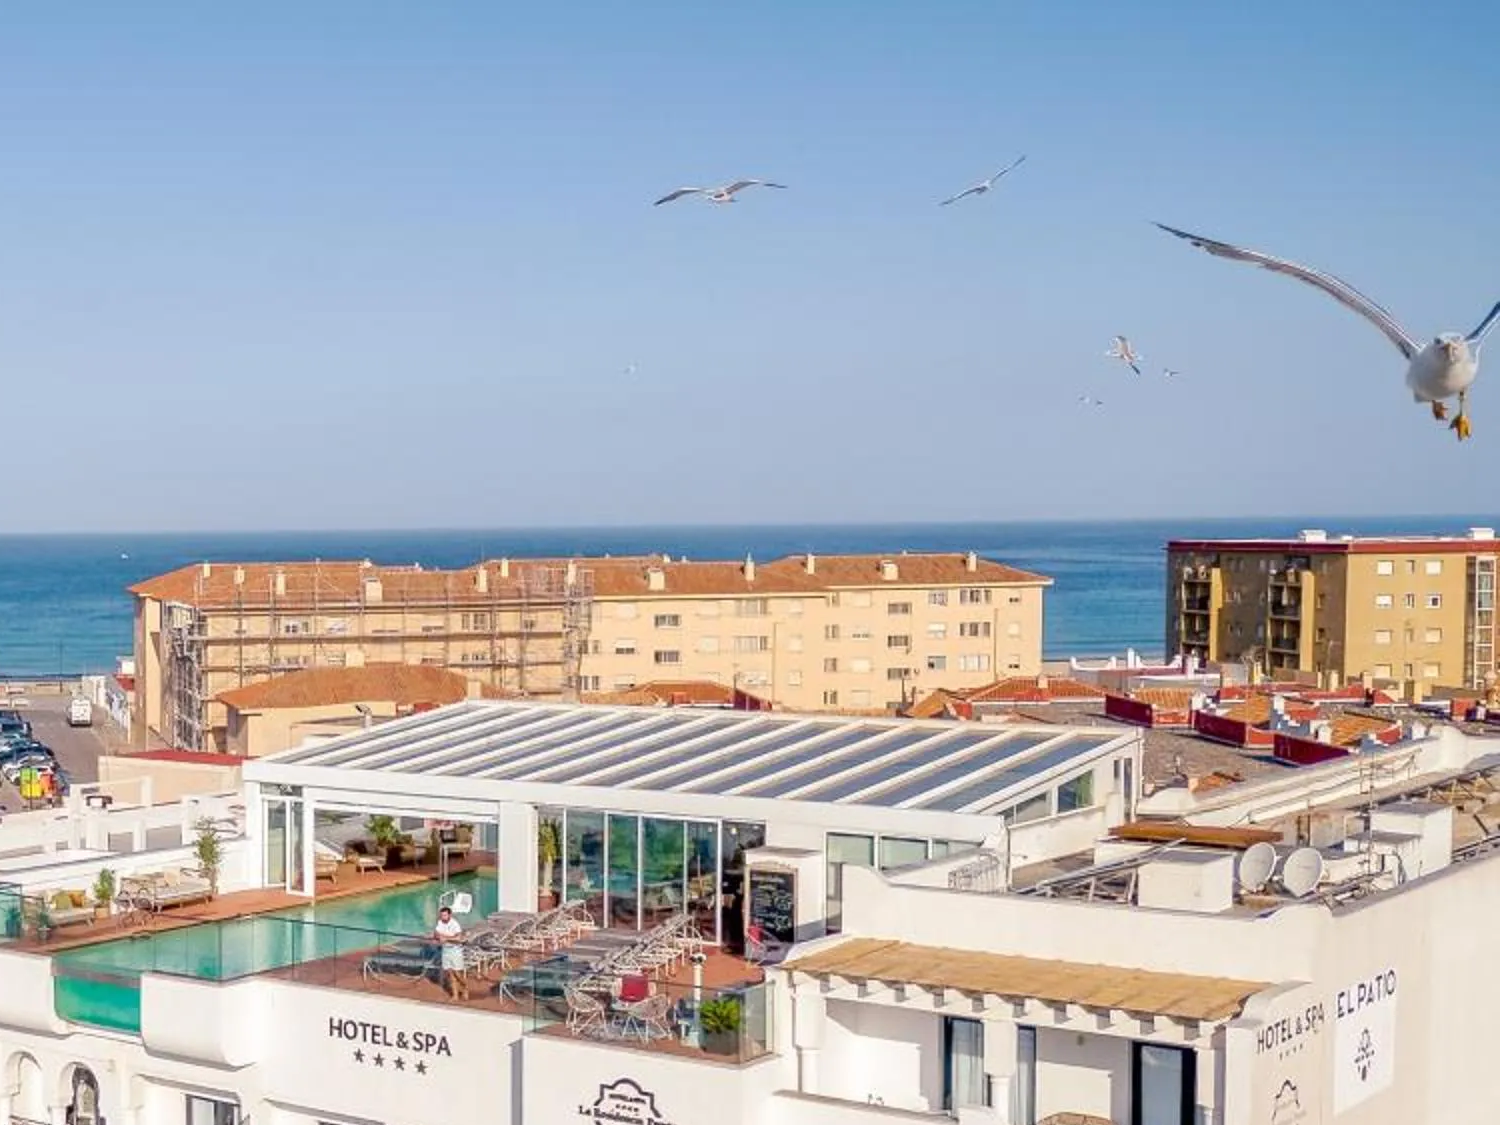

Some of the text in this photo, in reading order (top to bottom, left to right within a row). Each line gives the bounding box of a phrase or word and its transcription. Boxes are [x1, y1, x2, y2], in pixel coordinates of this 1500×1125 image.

[1337, 969, 1396, 1019] EL PATIO
[328, 1016, 393, 1047] HOTEL
[412, 1031, 452, 1057] SPA
[1257, 1016, 1293, 1054] HOTEL
[1305, 1002, 1325, 1031] SPA
